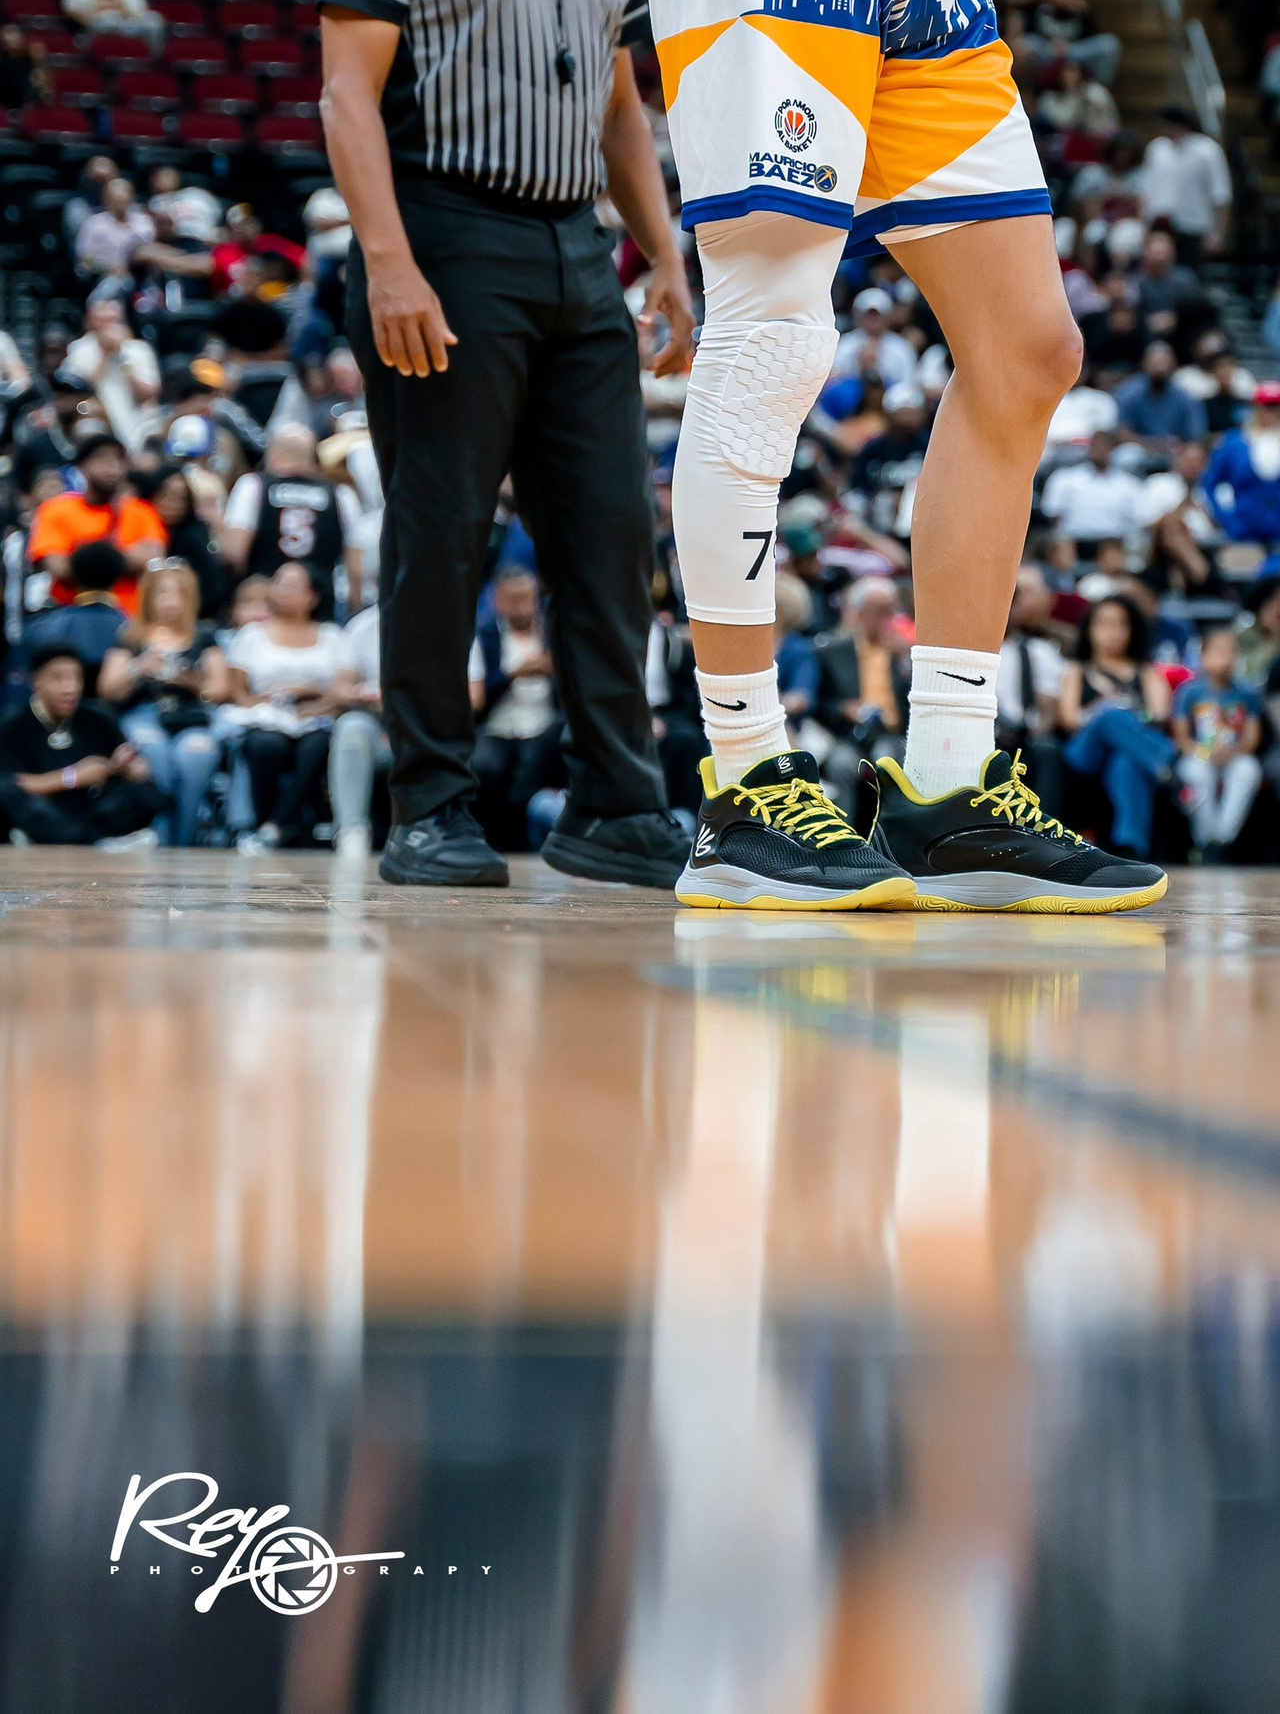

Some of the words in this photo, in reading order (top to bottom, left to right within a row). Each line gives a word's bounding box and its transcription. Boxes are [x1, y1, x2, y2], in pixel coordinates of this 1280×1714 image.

[777, 98, 792, 114] POR
[792, 98, 816, 122] AMOR
[776, 129, 785, 143] AL
[784, 136, 813, 153] BASKET
[749, 151, 817, 173] MAURICIO
[749, 162, 815, 189] BAEZ
[742, 530, 777, 580] 7
